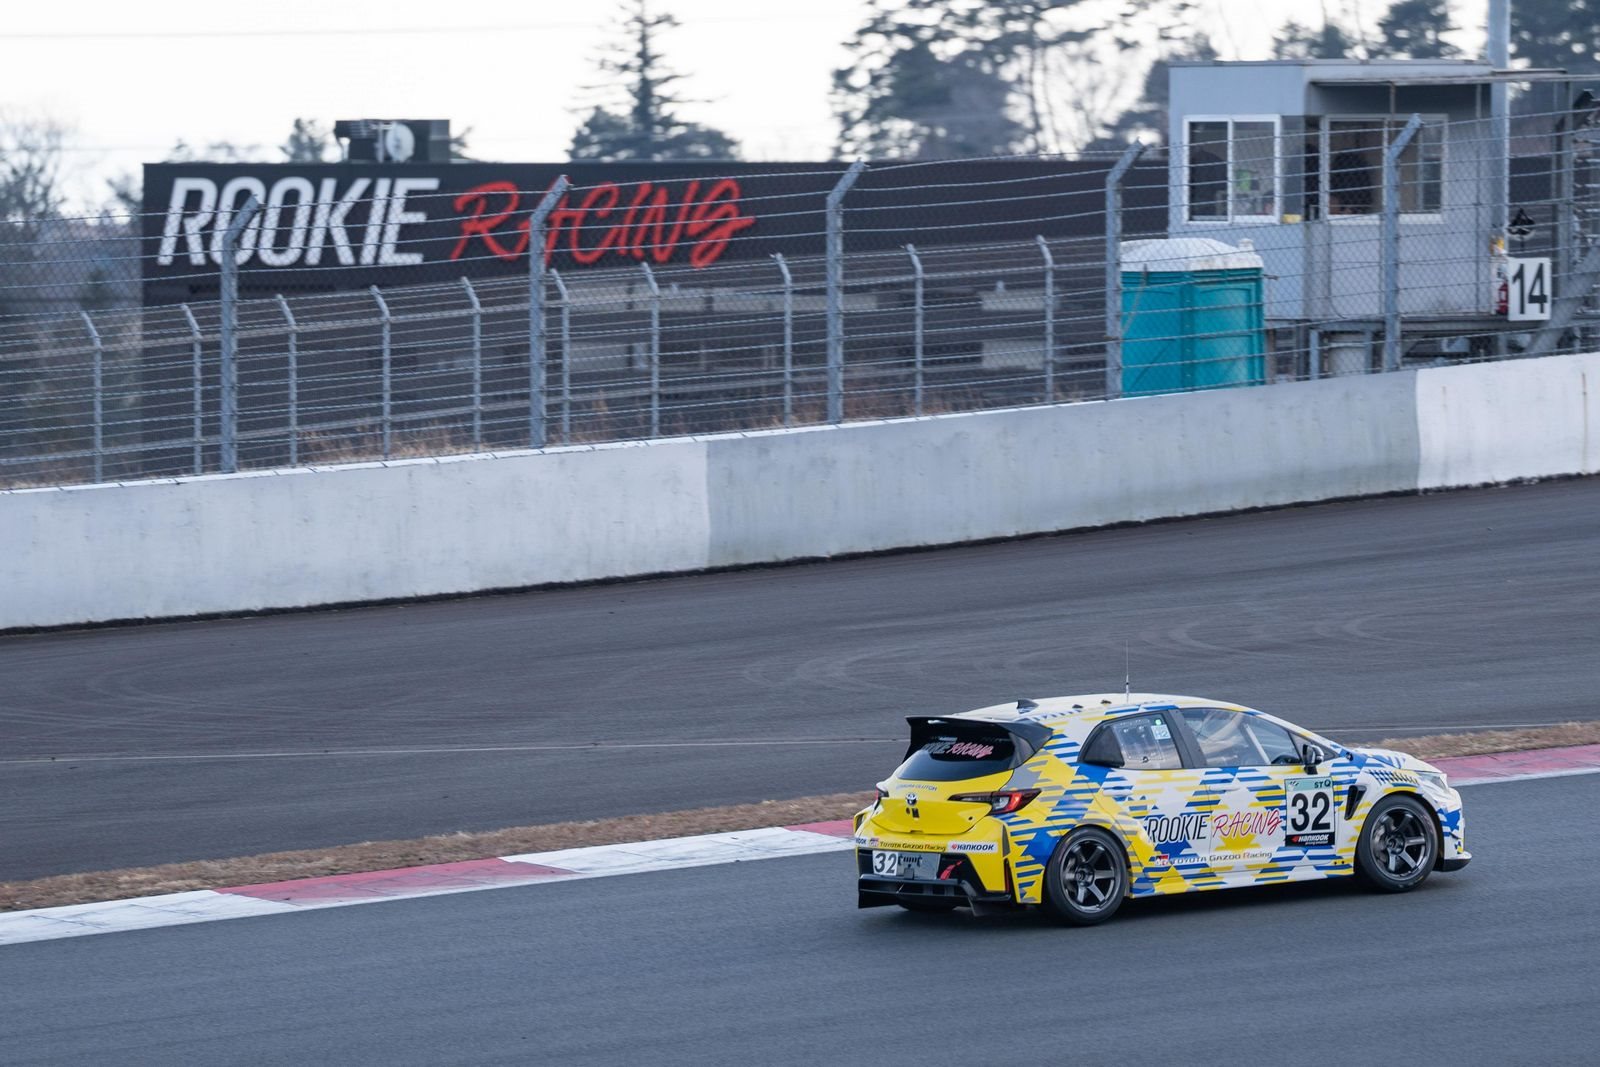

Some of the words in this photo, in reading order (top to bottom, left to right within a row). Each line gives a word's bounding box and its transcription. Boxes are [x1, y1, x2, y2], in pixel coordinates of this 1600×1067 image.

[157, 176, 440, 267] ROOKIE
[449, 177, 757, 269] RACING
[1512, 262, 1548, 315] 14
[1146, 814, 1211, 843] ROOKIE
[1213, 809, 1283, 837] RACING
[1291, 791, 1331, 832] 32
[874, 853, 897, 874] 32
[1243, 851, 1273, 860] Racing
